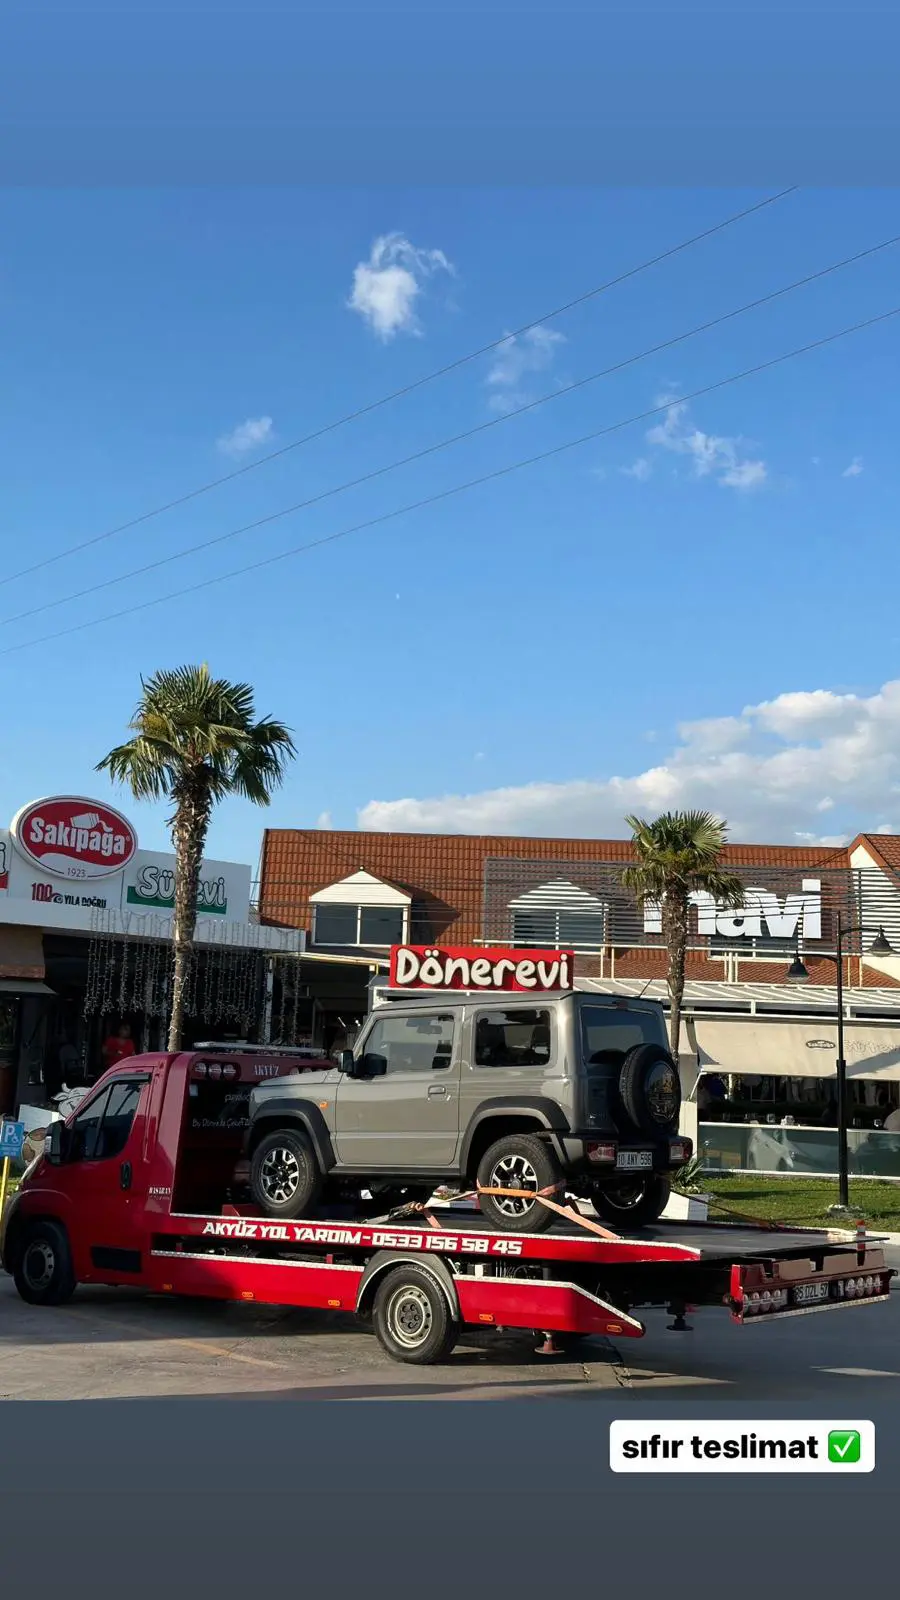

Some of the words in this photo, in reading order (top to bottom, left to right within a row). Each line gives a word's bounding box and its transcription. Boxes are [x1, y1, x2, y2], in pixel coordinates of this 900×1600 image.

[30, 817, 125, 857] Sakıpağa
[67, 867, 86, 878] 1923
[139, 866, 225, 906] Süevi
[32, 882, 52, 902] 100
[64, 894, 80, 906] YILA
[81, 896, 107, 909] DOĞRU
[396, 947, 570, 990] Dönerevi
[4, 1125, 15, 1142] P
[202, 1221, 257, 1237] AKYÜZ
[261, 1225, 290, 1240] YOL
[425, 1236, 457, 1251] 156
[461, 1238, 489, 1253] 58
[493, 1241, 523, 1255] 45
